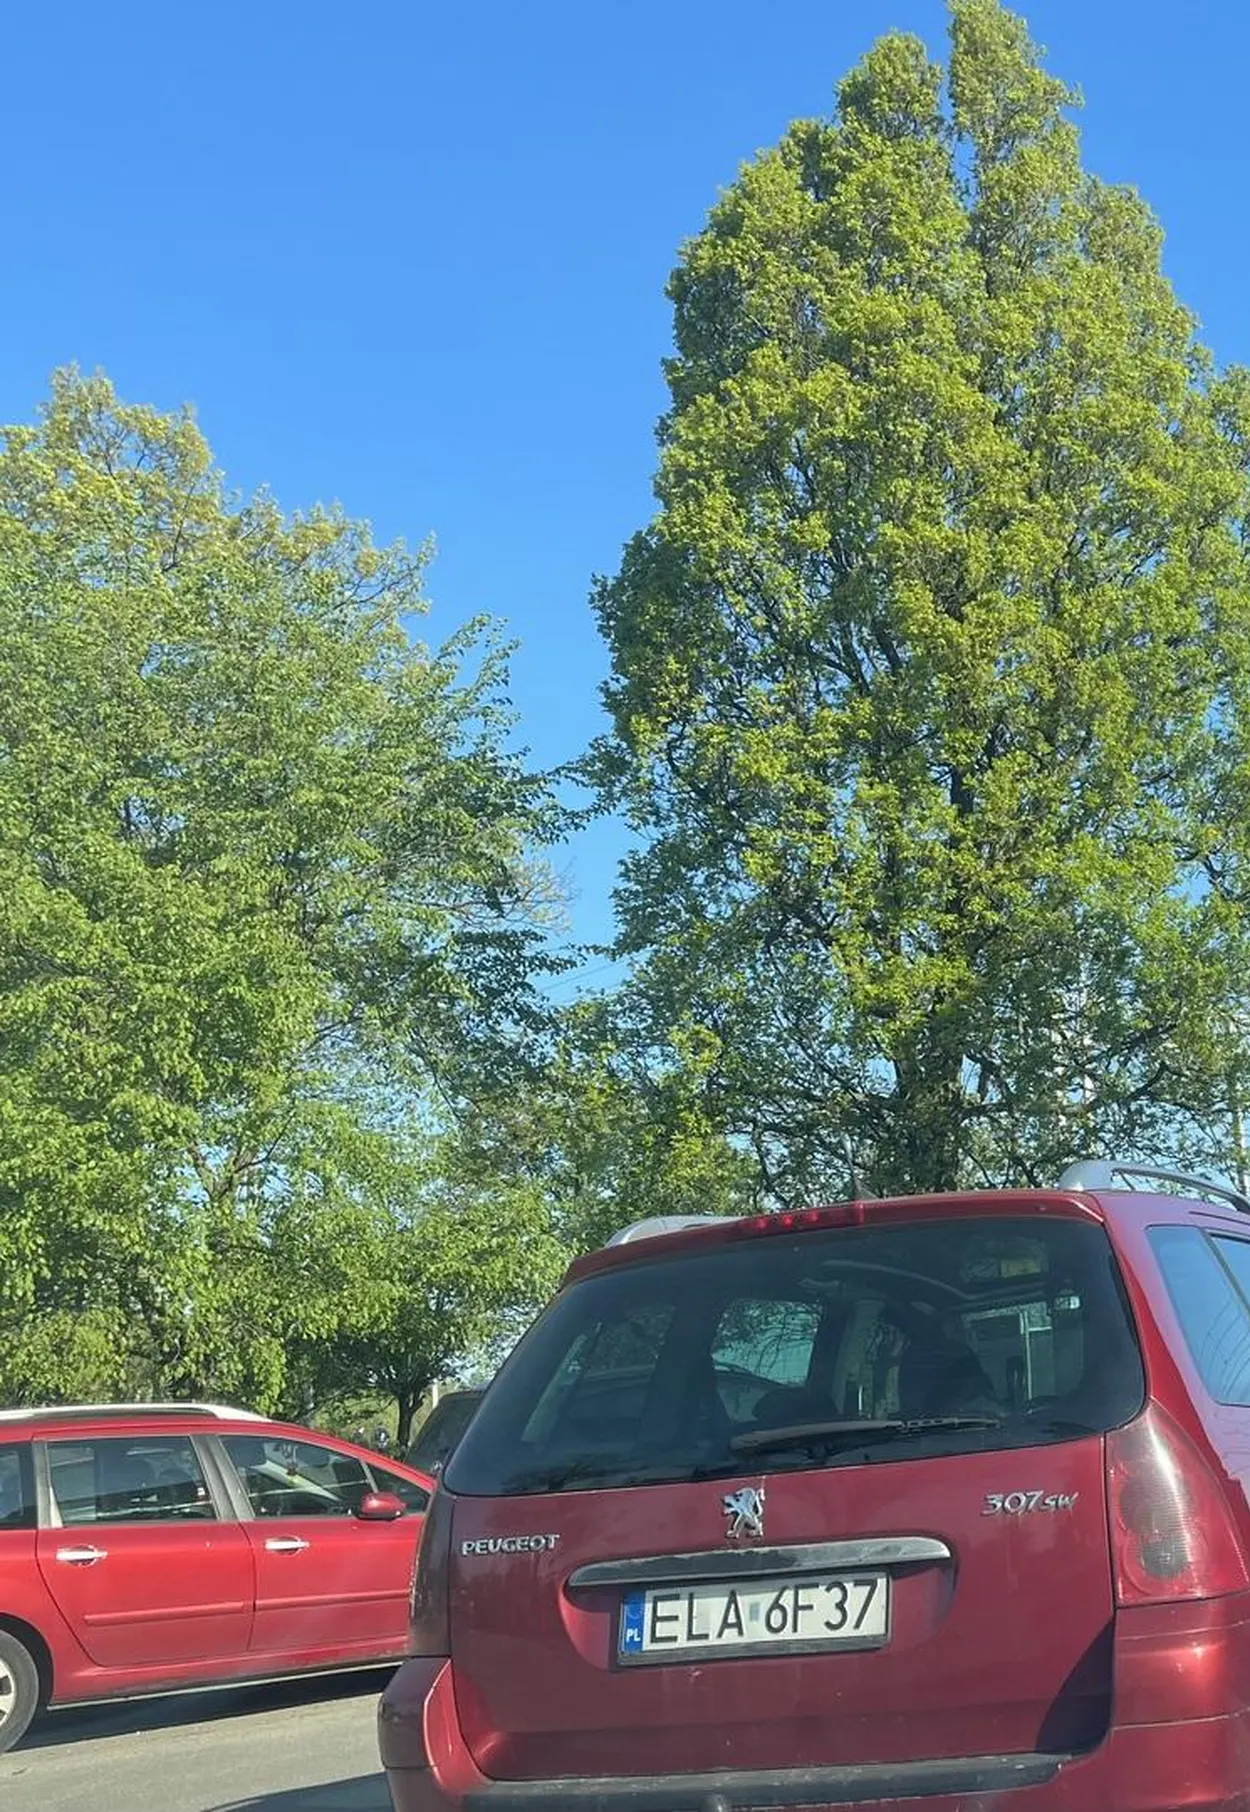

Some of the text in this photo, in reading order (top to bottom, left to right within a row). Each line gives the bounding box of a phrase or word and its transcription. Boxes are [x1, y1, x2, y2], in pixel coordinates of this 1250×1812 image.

[461, 1534, 560, 1556] PEUGEOT
[650, 1579, 878, 1644] ELA 6F37
[626, 1627, 641, 1642] PL
